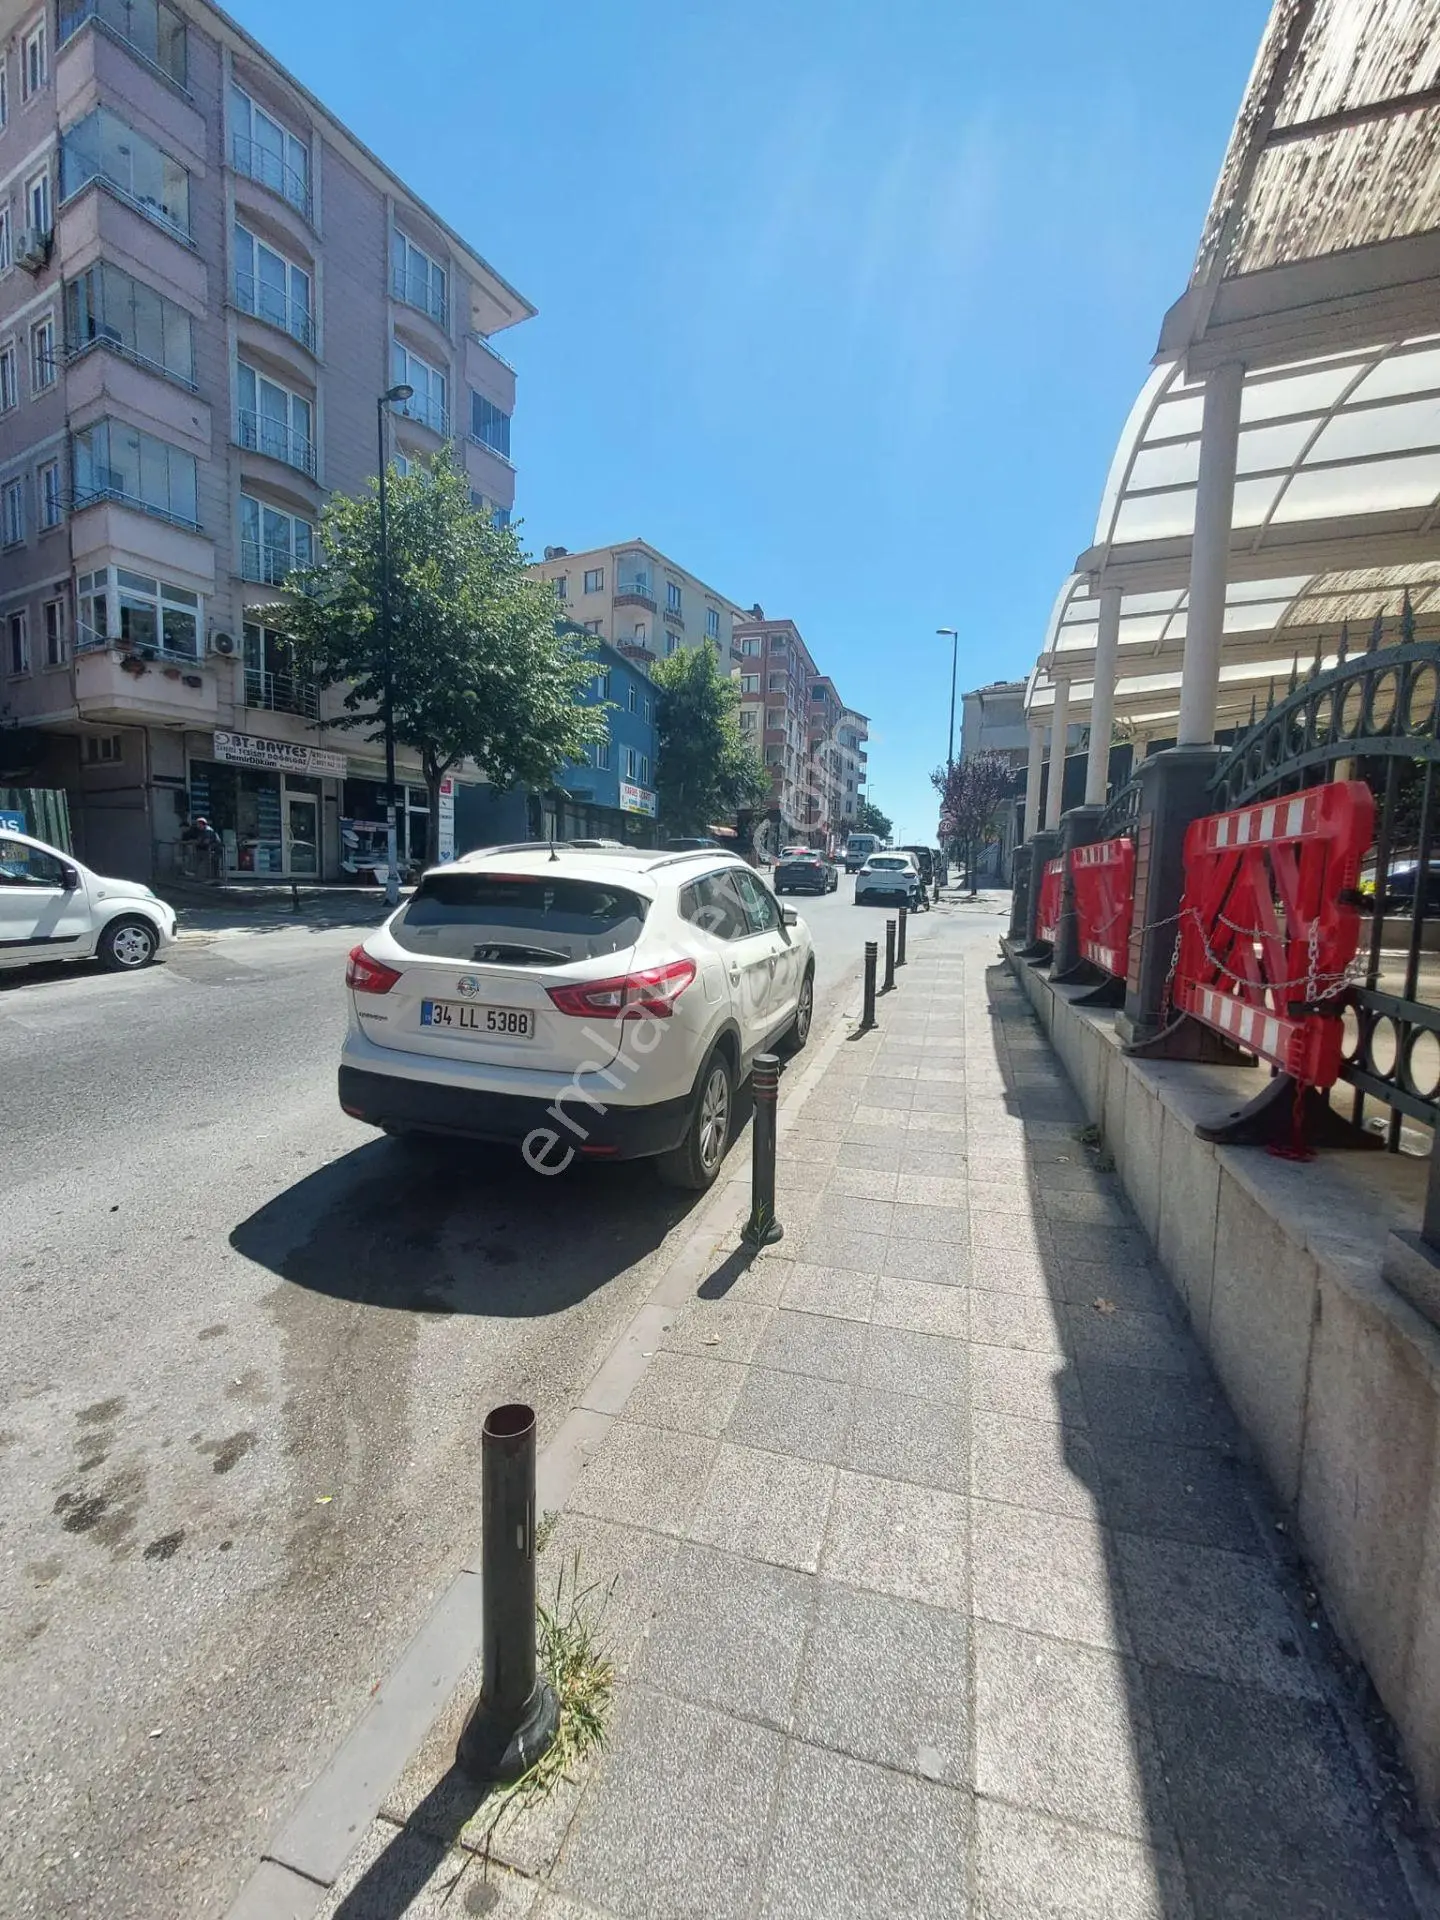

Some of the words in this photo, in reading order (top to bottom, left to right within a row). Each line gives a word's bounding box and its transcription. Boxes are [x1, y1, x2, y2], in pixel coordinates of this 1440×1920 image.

[433, 1004, 452, 1026] 34
[460, 1007, 479, 1029] LL
[487, 1010, 528, 1034] 5388
